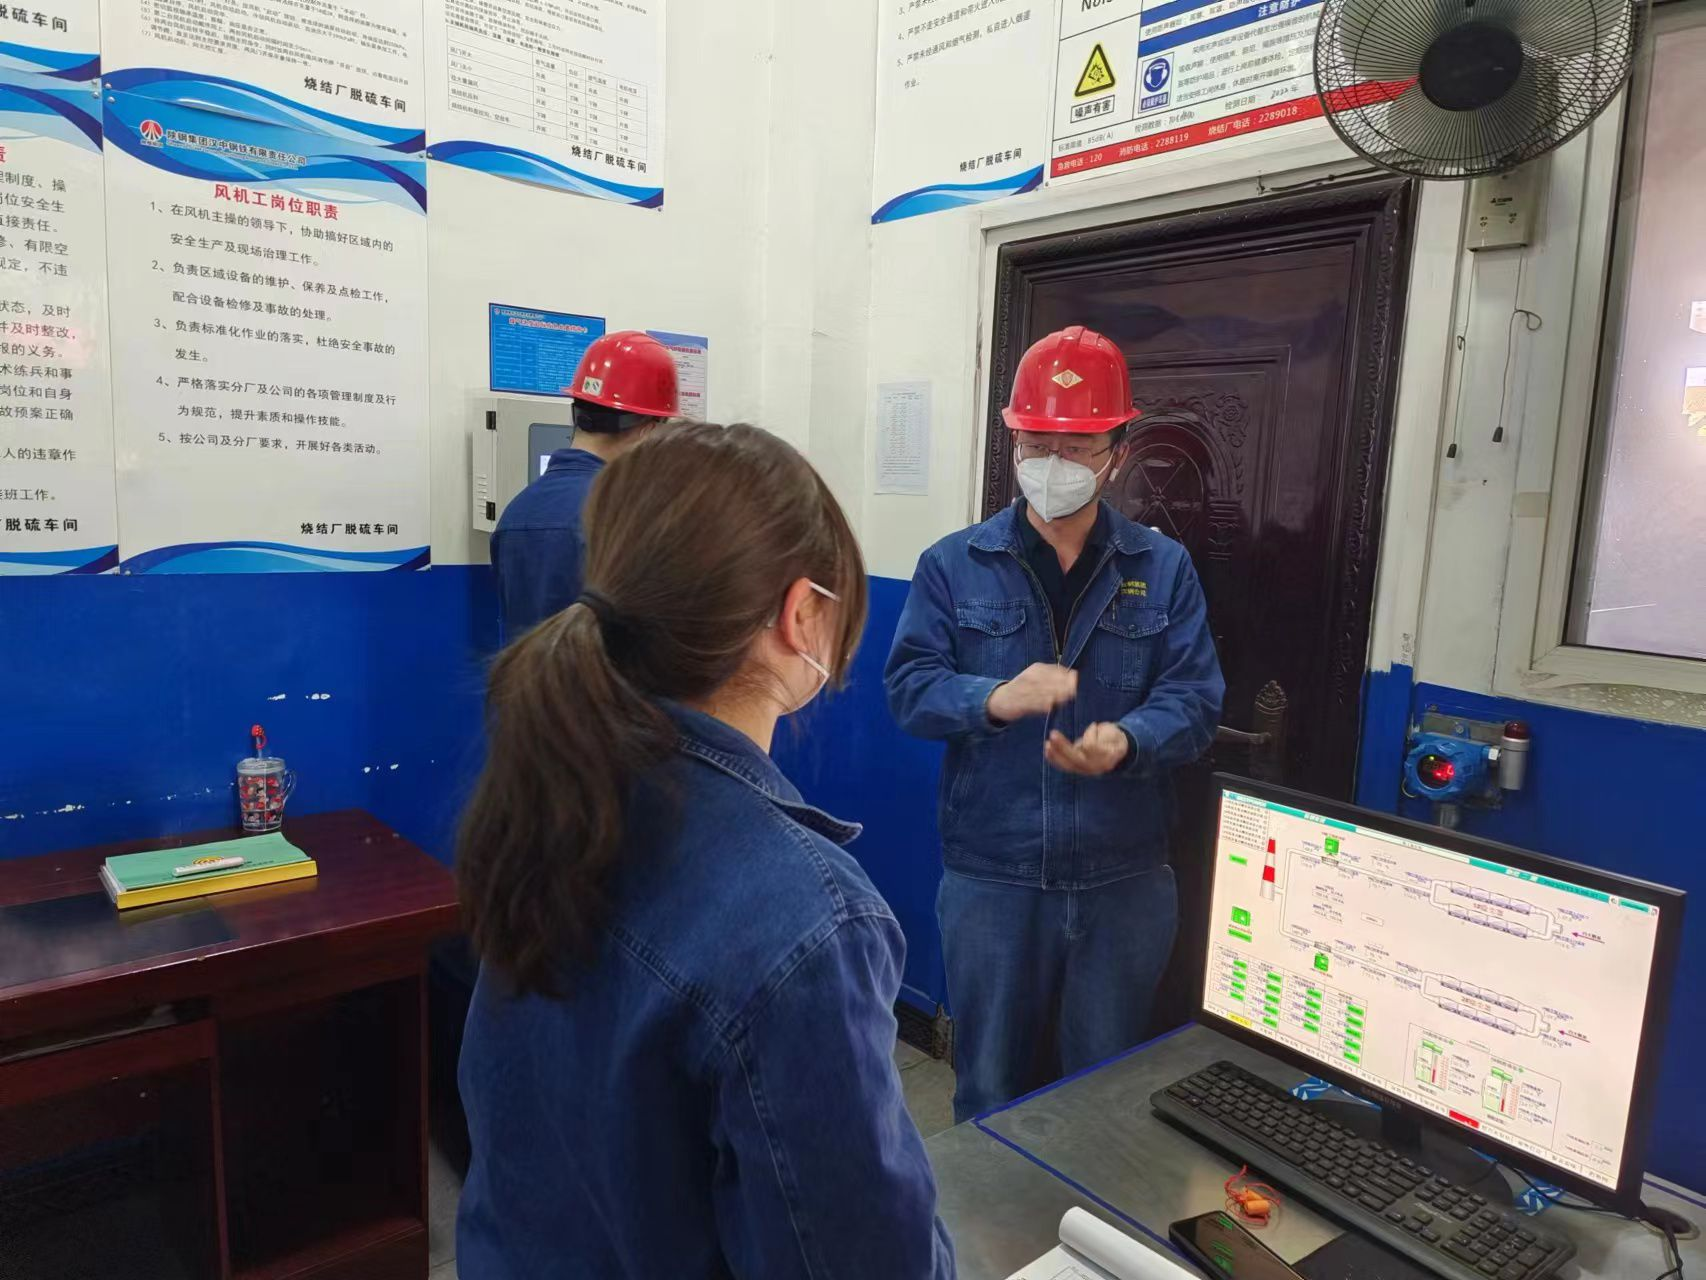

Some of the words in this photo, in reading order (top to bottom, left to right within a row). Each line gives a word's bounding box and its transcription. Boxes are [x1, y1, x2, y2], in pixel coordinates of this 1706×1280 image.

[304, 76, 406, 112] 烧结厂脱硫车间
[1075, 99, 1110, 118] 噪声有害
[571, 145, 647, 173] 烧结厂脱硫车间
[959, 148, 1022, 172] 烧结厂脱硫车间
[214, 183, 339, 220] 风机工岗位职责
[170, 233, 319, 266] 安全生产及现场治理工作。
[173, 291, 332, 321] 配合设备检修及事故的处理。
[175, 348, 208, 362] 发生。
[0, 383, 72, 400] 岗位和自身
[0, 405, 73, 421] 故预案正确
[177, 405, 347, 427] 为规范，提升素质和操作技能。
[301, 523, 398, 535] 烧结厂脱硫车间
